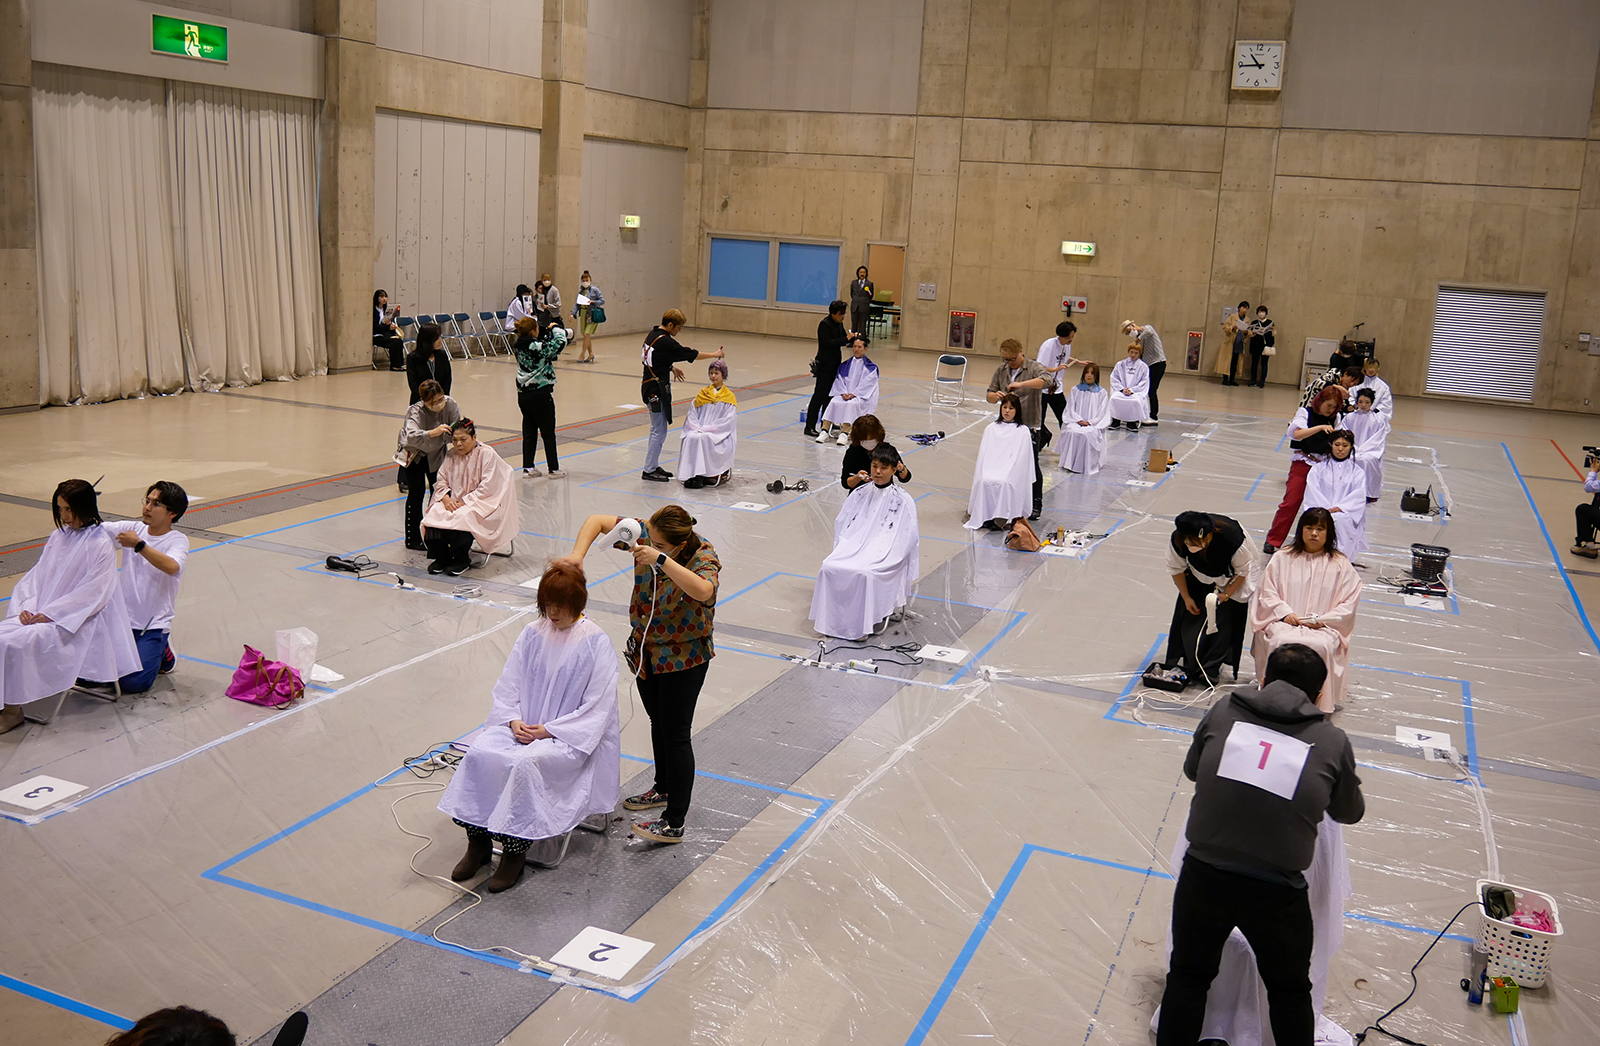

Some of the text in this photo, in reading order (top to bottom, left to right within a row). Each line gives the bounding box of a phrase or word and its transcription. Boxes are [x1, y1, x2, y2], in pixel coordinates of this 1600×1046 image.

[1256, 43, 1264, 51] 12
[1237, 60, 1244, 68] 9
[1273, 61, 1280, 70] 3
[1253, 79, 1260, 87] 6
[934, 650, 951, 658] 5
[1257, 740, 1273, 770] 1
[23, 786, 54, 799] 3
[588, 942, 620, 962] 2
